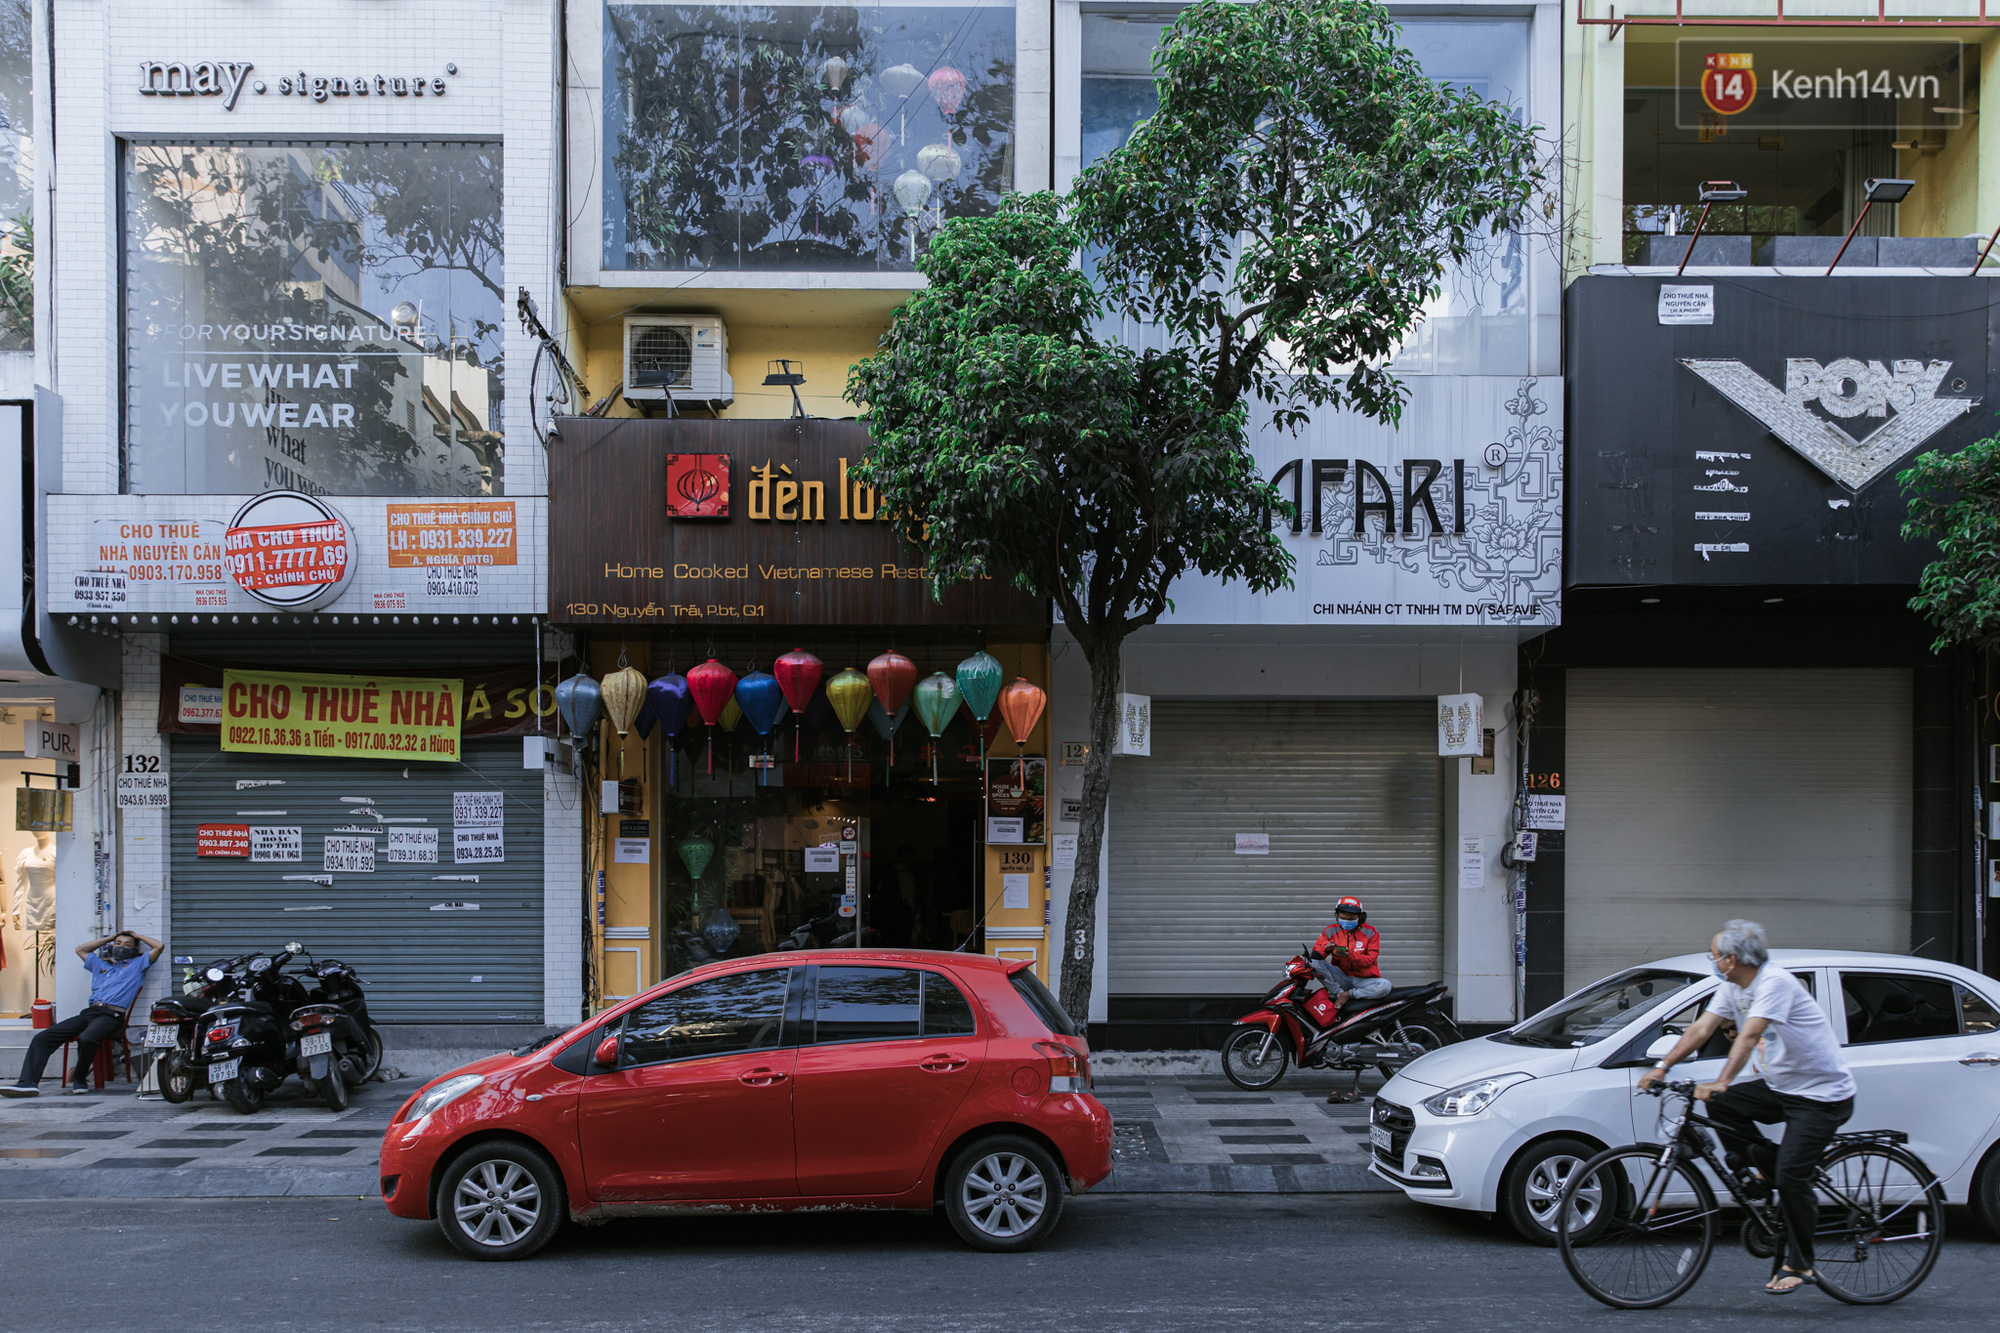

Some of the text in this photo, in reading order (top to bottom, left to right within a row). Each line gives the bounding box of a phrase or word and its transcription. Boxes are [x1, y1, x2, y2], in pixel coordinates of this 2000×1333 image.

[278, 69, 447, 103] signature
[247, 363, 359, 389] WHAT
[1785, 357, 1953, 418] PONY
[240, 403, 356, 428] WEAR
[266, 424, 307, 466] what
[748, 457, 825, 520] đèn
[1261, 458, 1467, 535] AFARI
[390, 507, 512, 526] CHO THUÊ NHÀ CHÍNH CHỦ
[120, 521, 200, 539] CHO THUÊ
[225, 521, 345, 551] NHÀ CHO THUÊ
[390, 528, 513, 550] LH 0931.339.227
[100, 541, 221, 561] NHÀ NGUYÊN CĂN
[412, 553, 494, 565] A. NGHĨA (MTG)
[225, 545, 346, 575] 0911.7777.69
[129, 564, 222, 581] 0903.170.958
[239, 567, 335, 588] LH CHÍNH CHỦ
[426, 565, 442, 579] CHO
[604, 562, 664, 578] Home
[674, 563, 749, 579] Cooked
[758, 563, 873, 580] Vietnamese
[74, 575, 126, 589] CHO THUÊ NHÀ
[427, 581, 479, 595] 0903.410.073
[74, 590, 93, 601] 0933
[95, 591, 110, 602] 957
[566, 603, 598, 615] 130
[602, 602, 664, 618] Nguyễn
[1313, 600, 1541, 616] CHI NHÁNH CT TNHH TM DV SAFAVIE
[184, 693, 213, 703] CHO THUÊ
[228, 681, 455, 727] CHO THUÊ NHÀ
[182, 707, 223, 718] 0962.377.67
[42, 730, 76, 754] PUR.
[229, 726, 455, 756] 0922.16.36.36 a Tiến 0917.00.32.32 a Hùng
[124, 755, 160, 773] 132
[118, 775, 168, 789] CHO THUÊ NHÀ
[1528, 772, 1561, 789] 126
[119, 794, 168, 806] 0943.61.9998
[455, 806, 503, 818] 0931.339.227
[199, 829, 249, 837] CHO THUÊ NHÀ
[254, 828, 276, 836] NHÀ
[390, 831, 437, 844] CHO THUÊ NHÀ
[457, 831, 499, 842] CHO THUÊ NHÀ
[199, 840, 249, 848] 0903.887.340
[277, 841, 300, 849] THUÊ
[326, 837, 374, 854] CHO THUÊ NHÀ
[390, 849, 437, 861] 0789.31.68.31
[456, 847, 503, 859] 0934.28.25.26
[1003, 851, 1031, 865] 130
[326, 855, 374, 871] 0934.101.592
[151, 1035, 172, 1043] 2905
